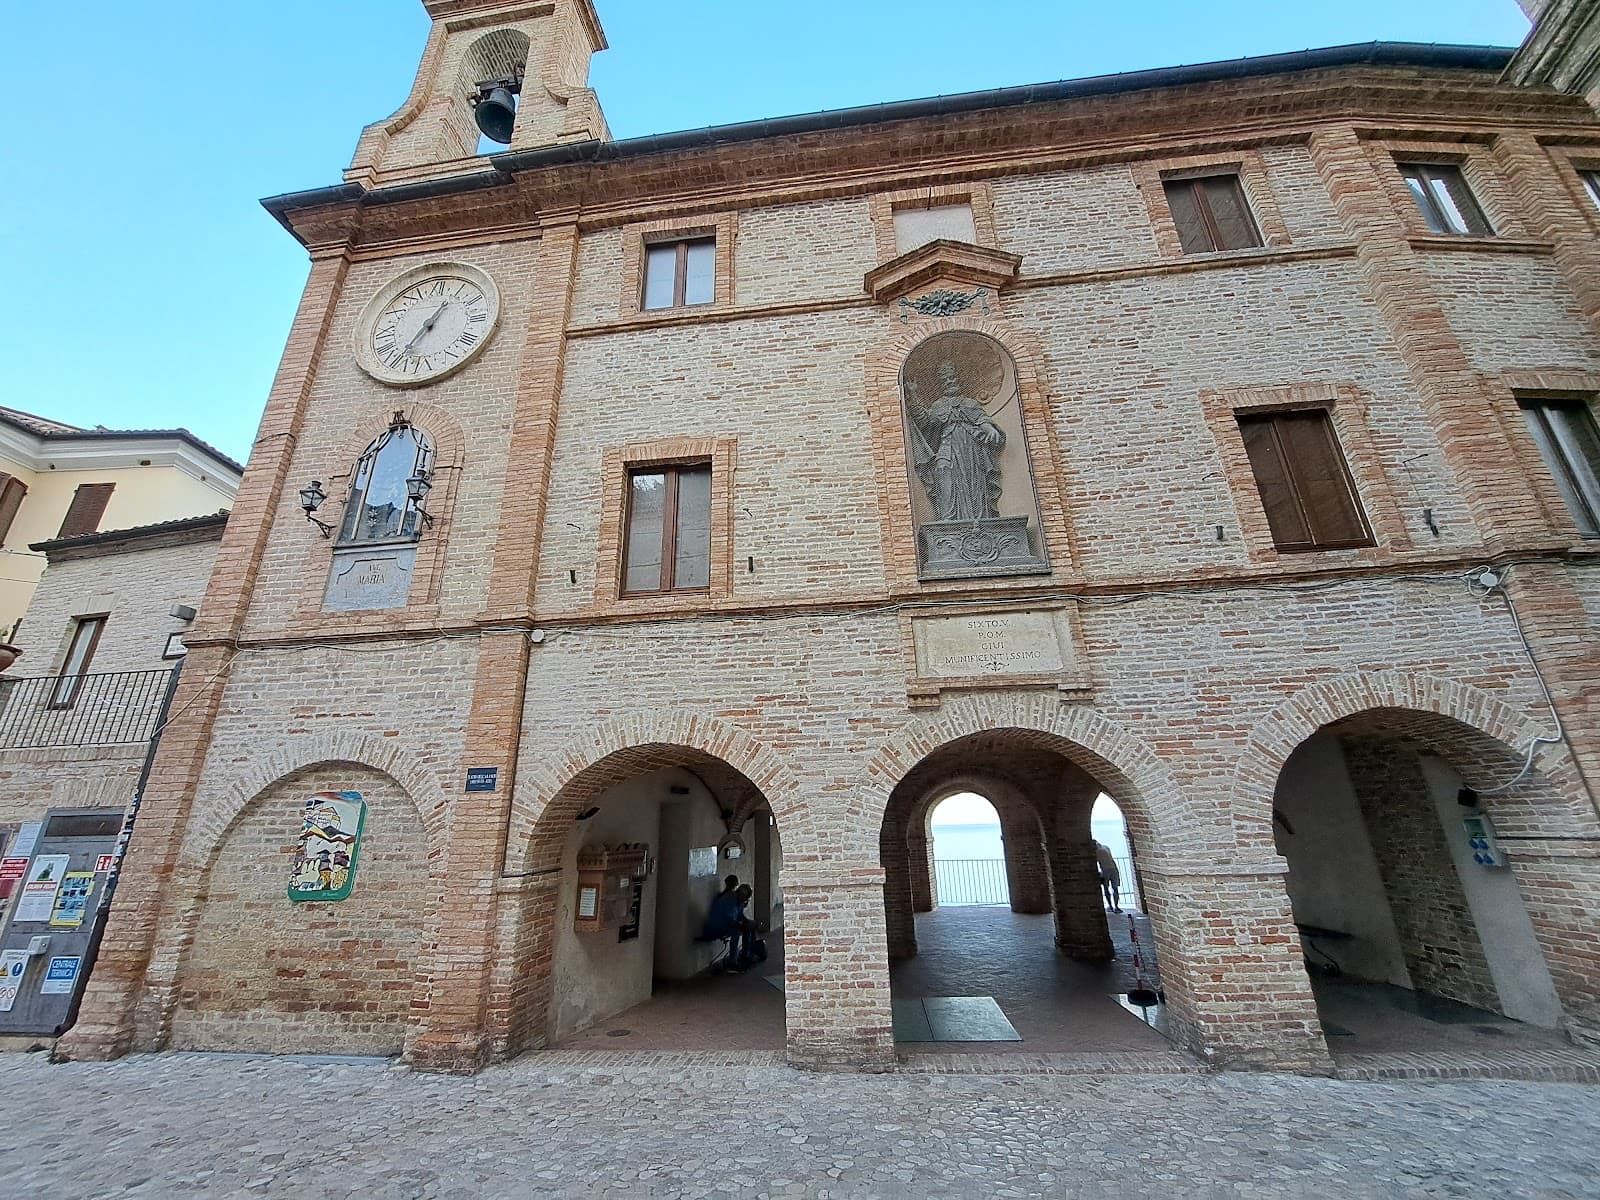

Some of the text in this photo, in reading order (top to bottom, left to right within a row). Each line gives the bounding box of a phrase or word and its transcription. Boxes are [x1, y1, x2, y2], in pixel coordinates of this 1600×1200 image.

[430, 281, 446, 296] XII
[469, 313, 487, 323] III
[358, 574, 384, 584] MARIA
[945, 651, 1041, 664] MUNIFICENTISSIMO
